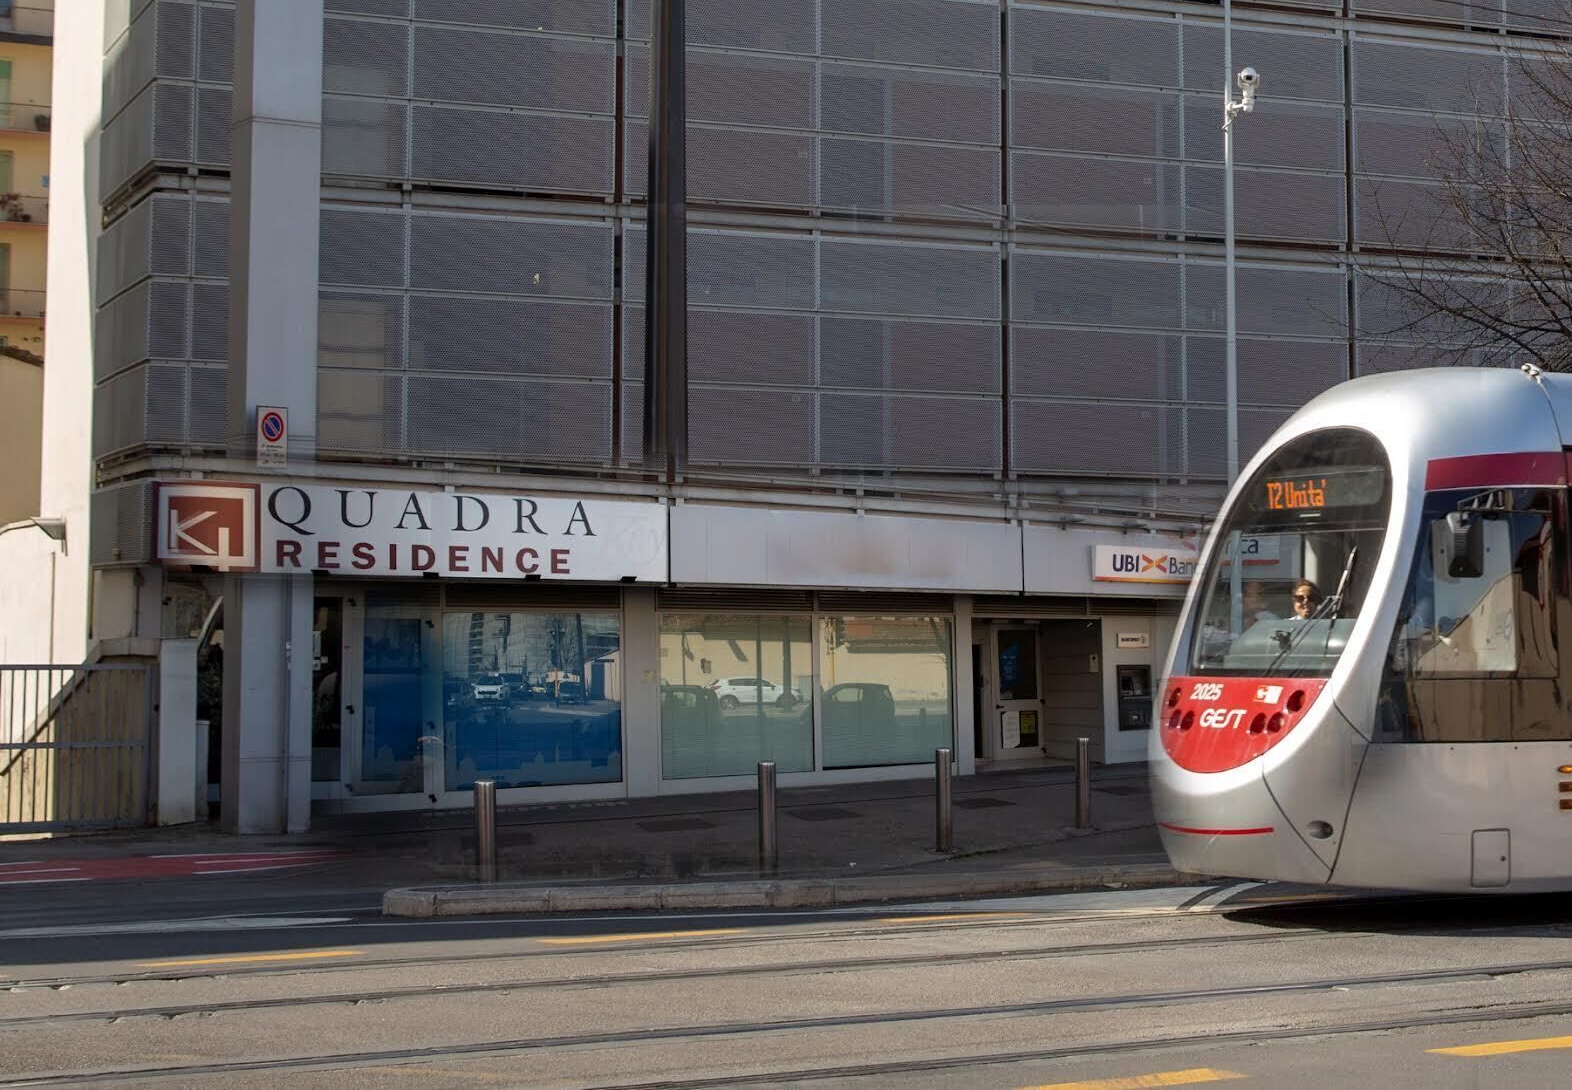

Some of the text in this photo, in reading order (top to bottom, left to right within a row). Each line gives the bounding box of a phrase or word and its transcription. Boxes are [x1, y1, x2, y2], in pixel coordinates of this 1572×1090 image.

[267, 486, 598, 538] QUADRA
[276, 539, 571, 575] RESIDENCE
[1112, 553, 1140, 573] UBI
[1189, 683, 1224, 701] 2025
[1200, 708, 1248, 729] GEST
